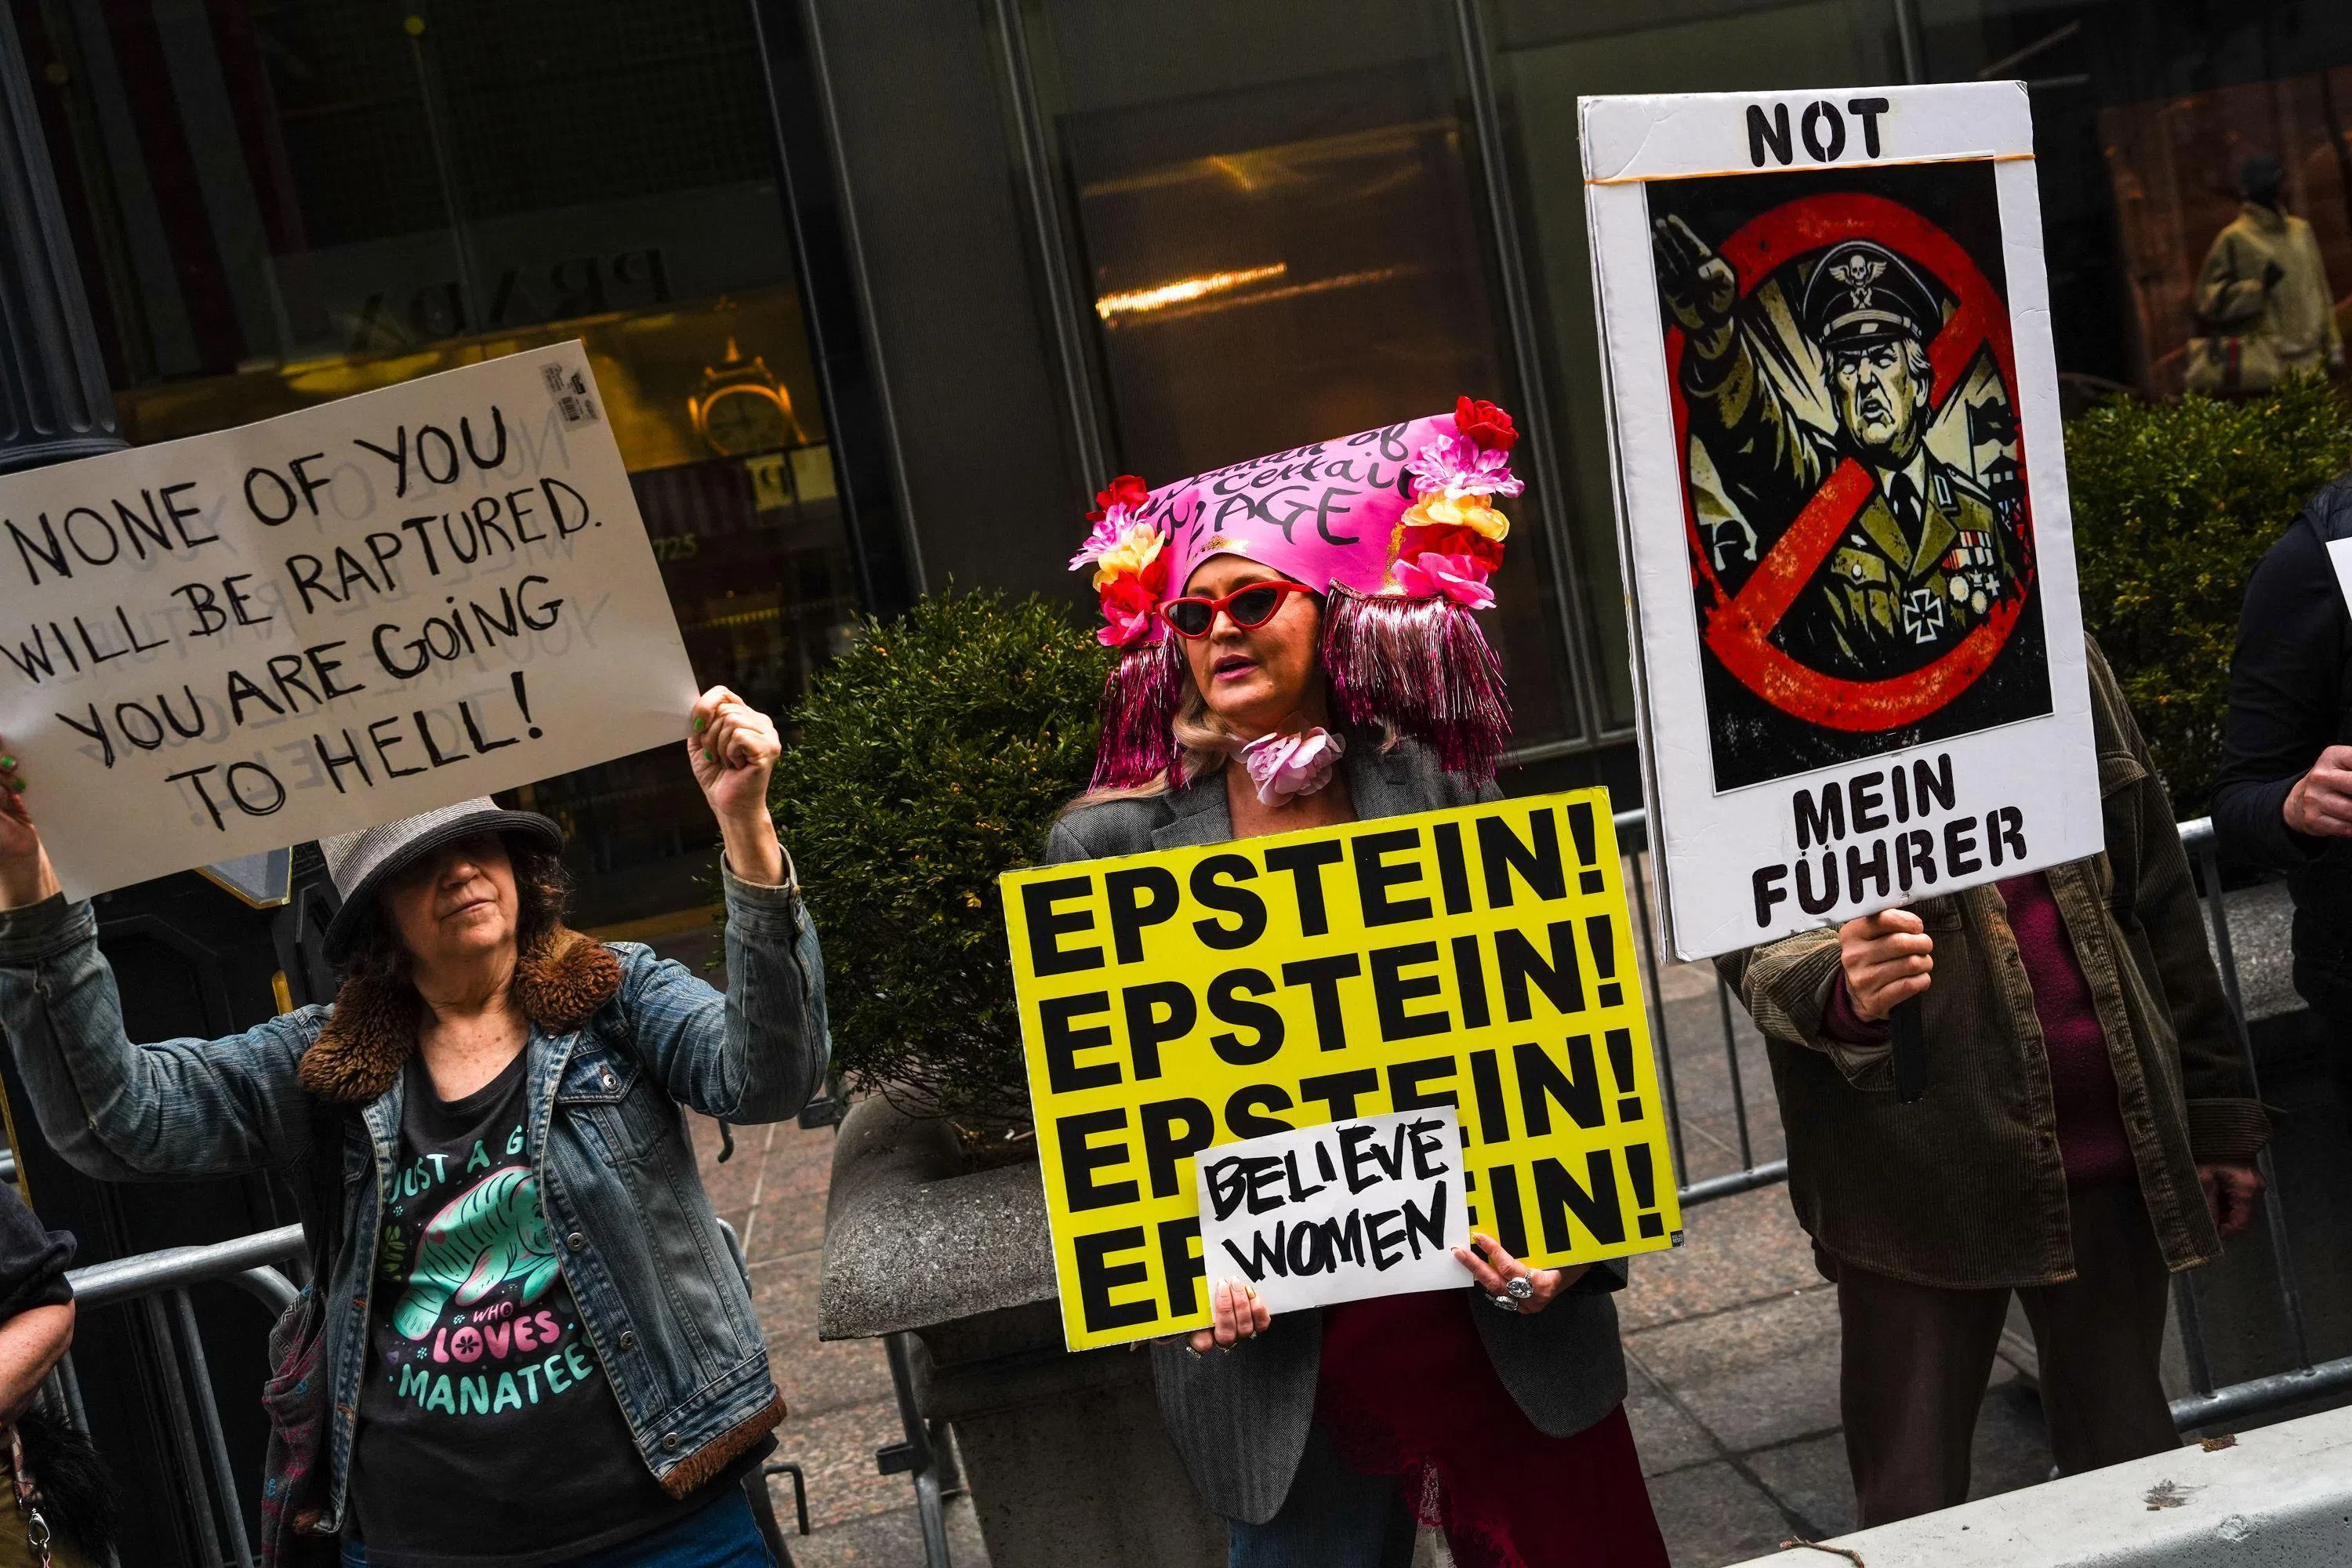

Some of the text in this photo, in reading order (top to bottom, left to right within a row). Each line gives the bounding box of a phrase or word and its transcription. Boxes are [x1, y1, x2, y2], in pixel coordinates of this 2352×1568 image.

[1746, 97, 1889, 168] NOT
[1347, 420, 1410, 462] of
[5, 405, 506, 586] NONE OF YOU
[0, 477, 602, 683] WILL BE RAPTURED.
[55, 684, 205, 769] YOU
[228, 640, 366, 726] ARE
[164, 670, 543, 832] TO HELL!
[1792, 753, 1956, 851] MEIN
[1020, 802, 1606, 978] EPSTEIN!
[1751, 805, 2027, 928] FÜHRER
[1038, 914, 1624, 1095] EPSTEIN!
[466, 1139, 491, 1174] A
[1203, 1117, 1450, 1221] BELIEVE
[1221, 1180, 1447, 1283] WOMEN
[433, 1310, 560, 1363] LOVES
[473, 1301, 514, 1323] WHO
